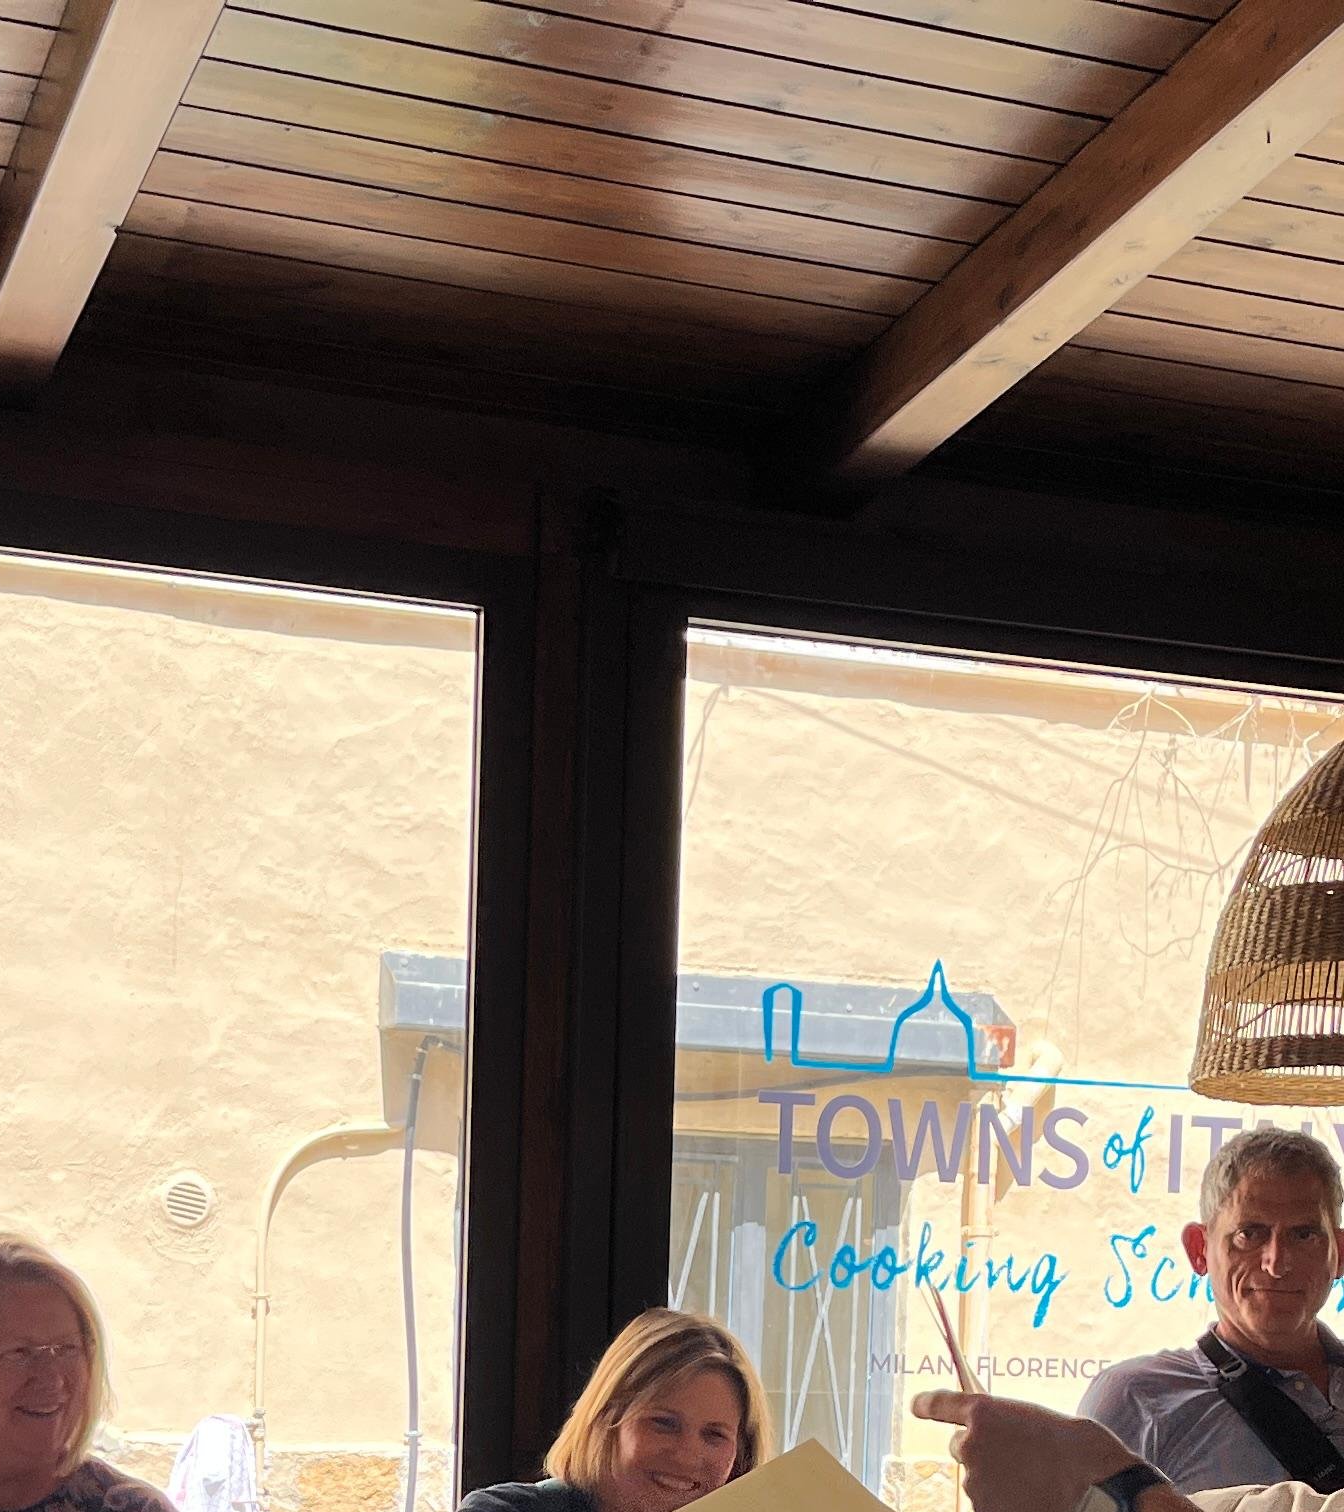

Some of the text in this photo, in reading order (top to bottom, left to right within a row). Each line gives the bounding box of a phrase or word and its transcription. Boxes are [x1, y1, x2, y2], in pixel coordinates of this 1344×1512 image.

[759, 1091, 1089, 1190] TOWNS
[1103, 1105, 1154, 1194] of
[773, 1220, 1069, 1328] Cooking
[870, 1353, 954, 1375] MILAN
